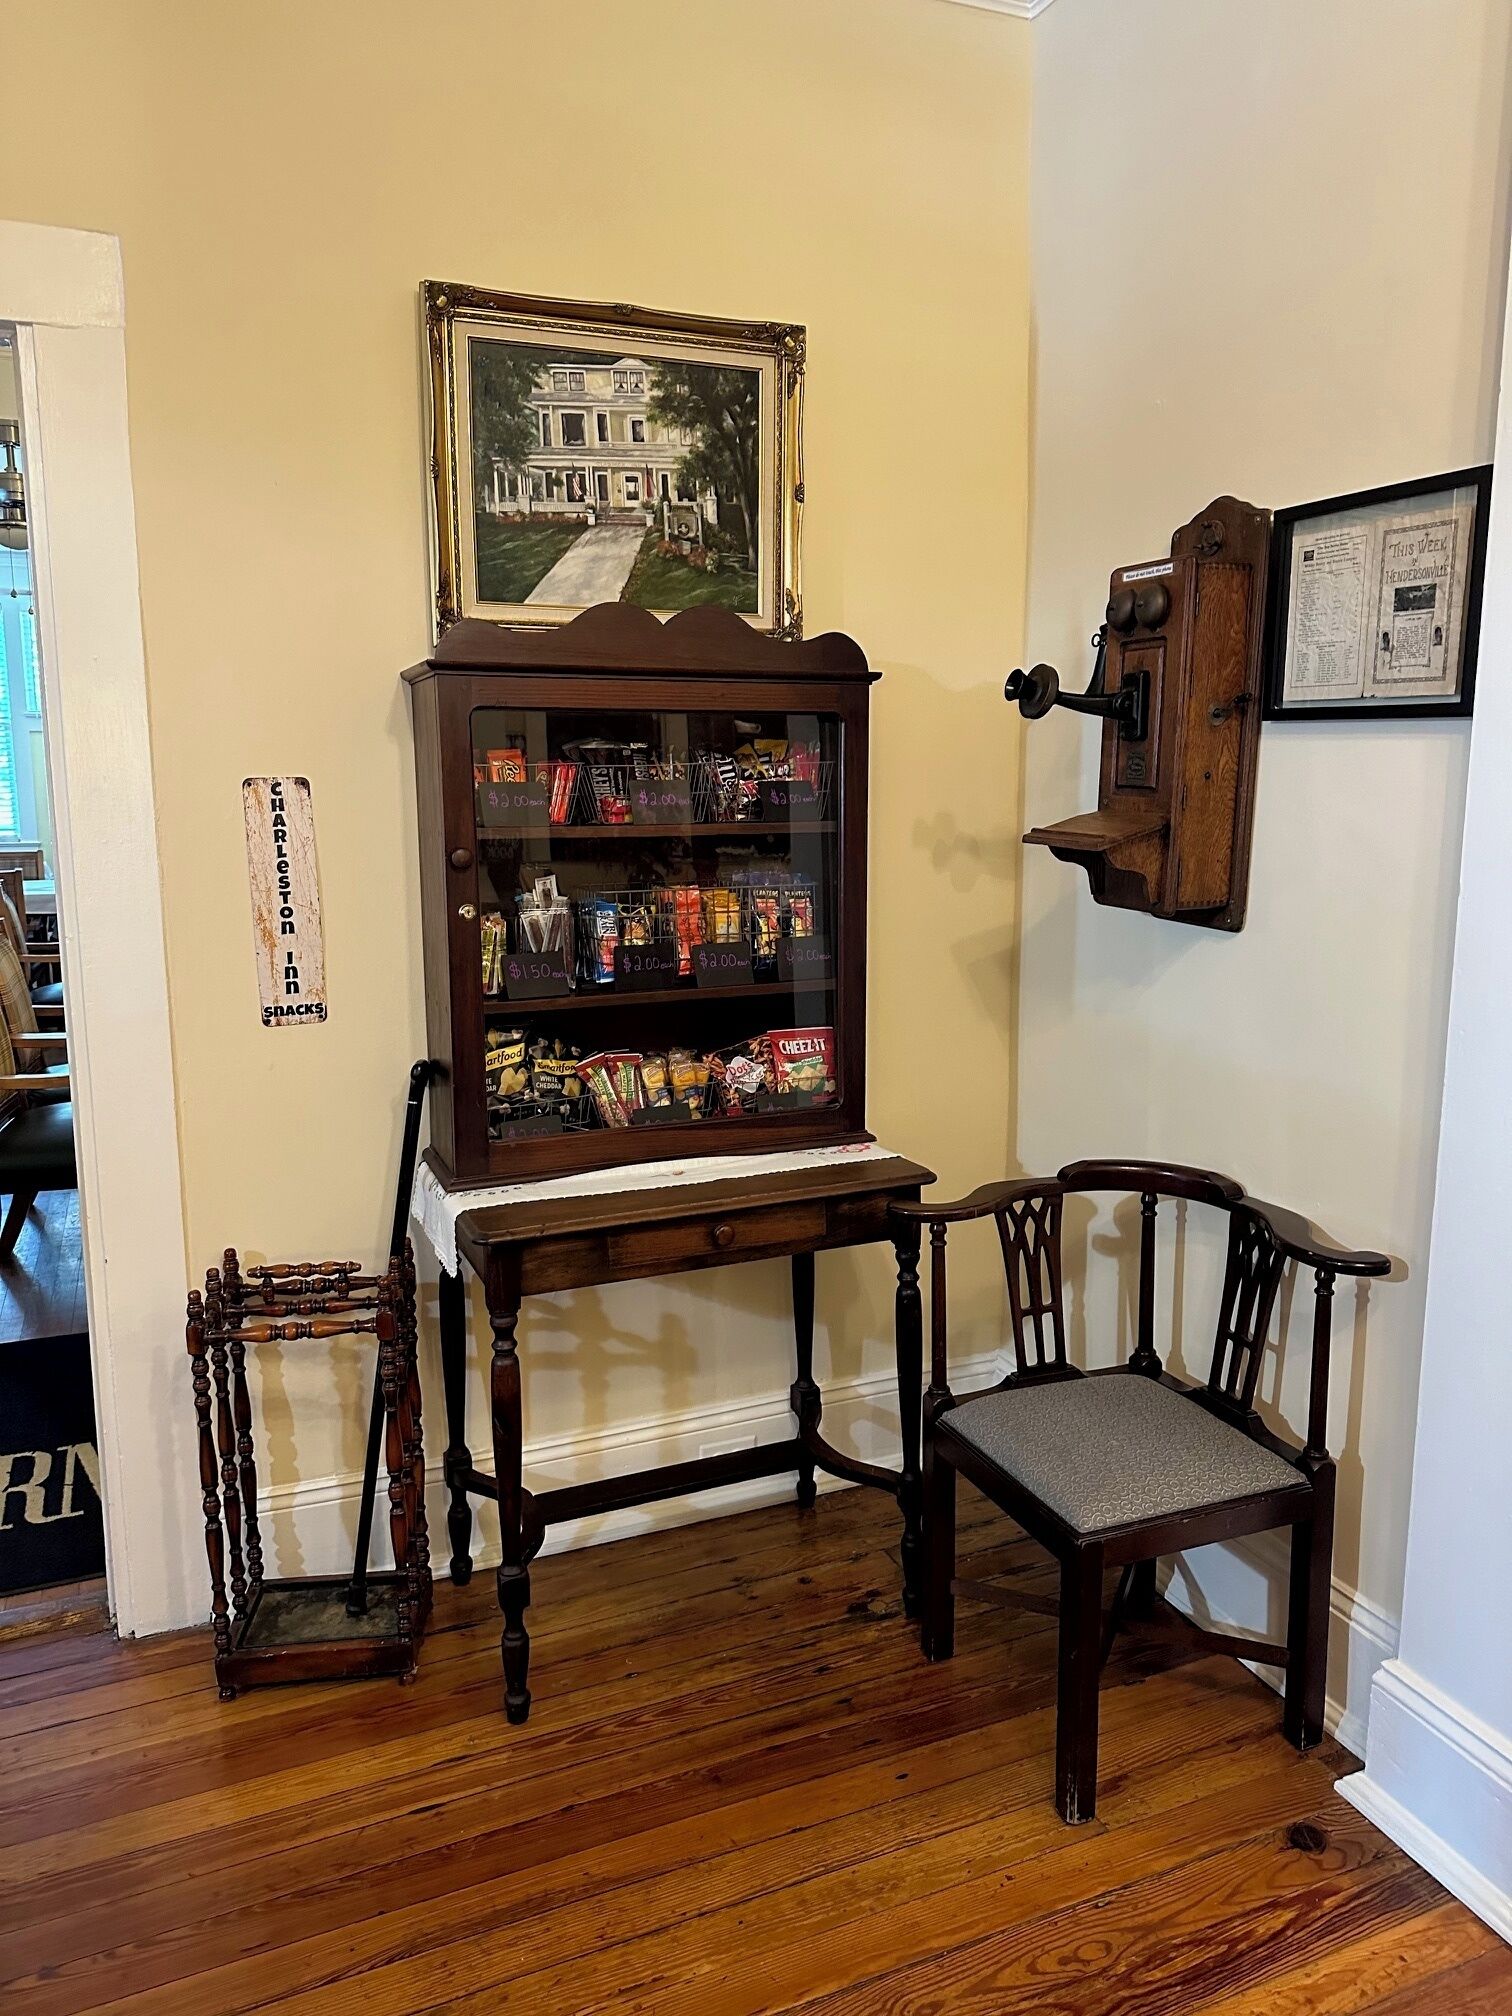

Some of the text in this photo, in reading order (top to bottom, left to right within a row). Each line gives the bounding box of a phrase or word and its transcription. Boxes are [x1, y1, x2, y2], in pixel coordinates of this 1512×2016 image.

[1389, 533, 1447, 558] THIS WEEK
[488, 790, 529, 808] $2.00
[639, 788, 676, 806] $2.00
[623, 953, 660, 974] $2.00
[700, 950, 736, 970] $2.00
[486, 1047, 523, 1067] artfood
